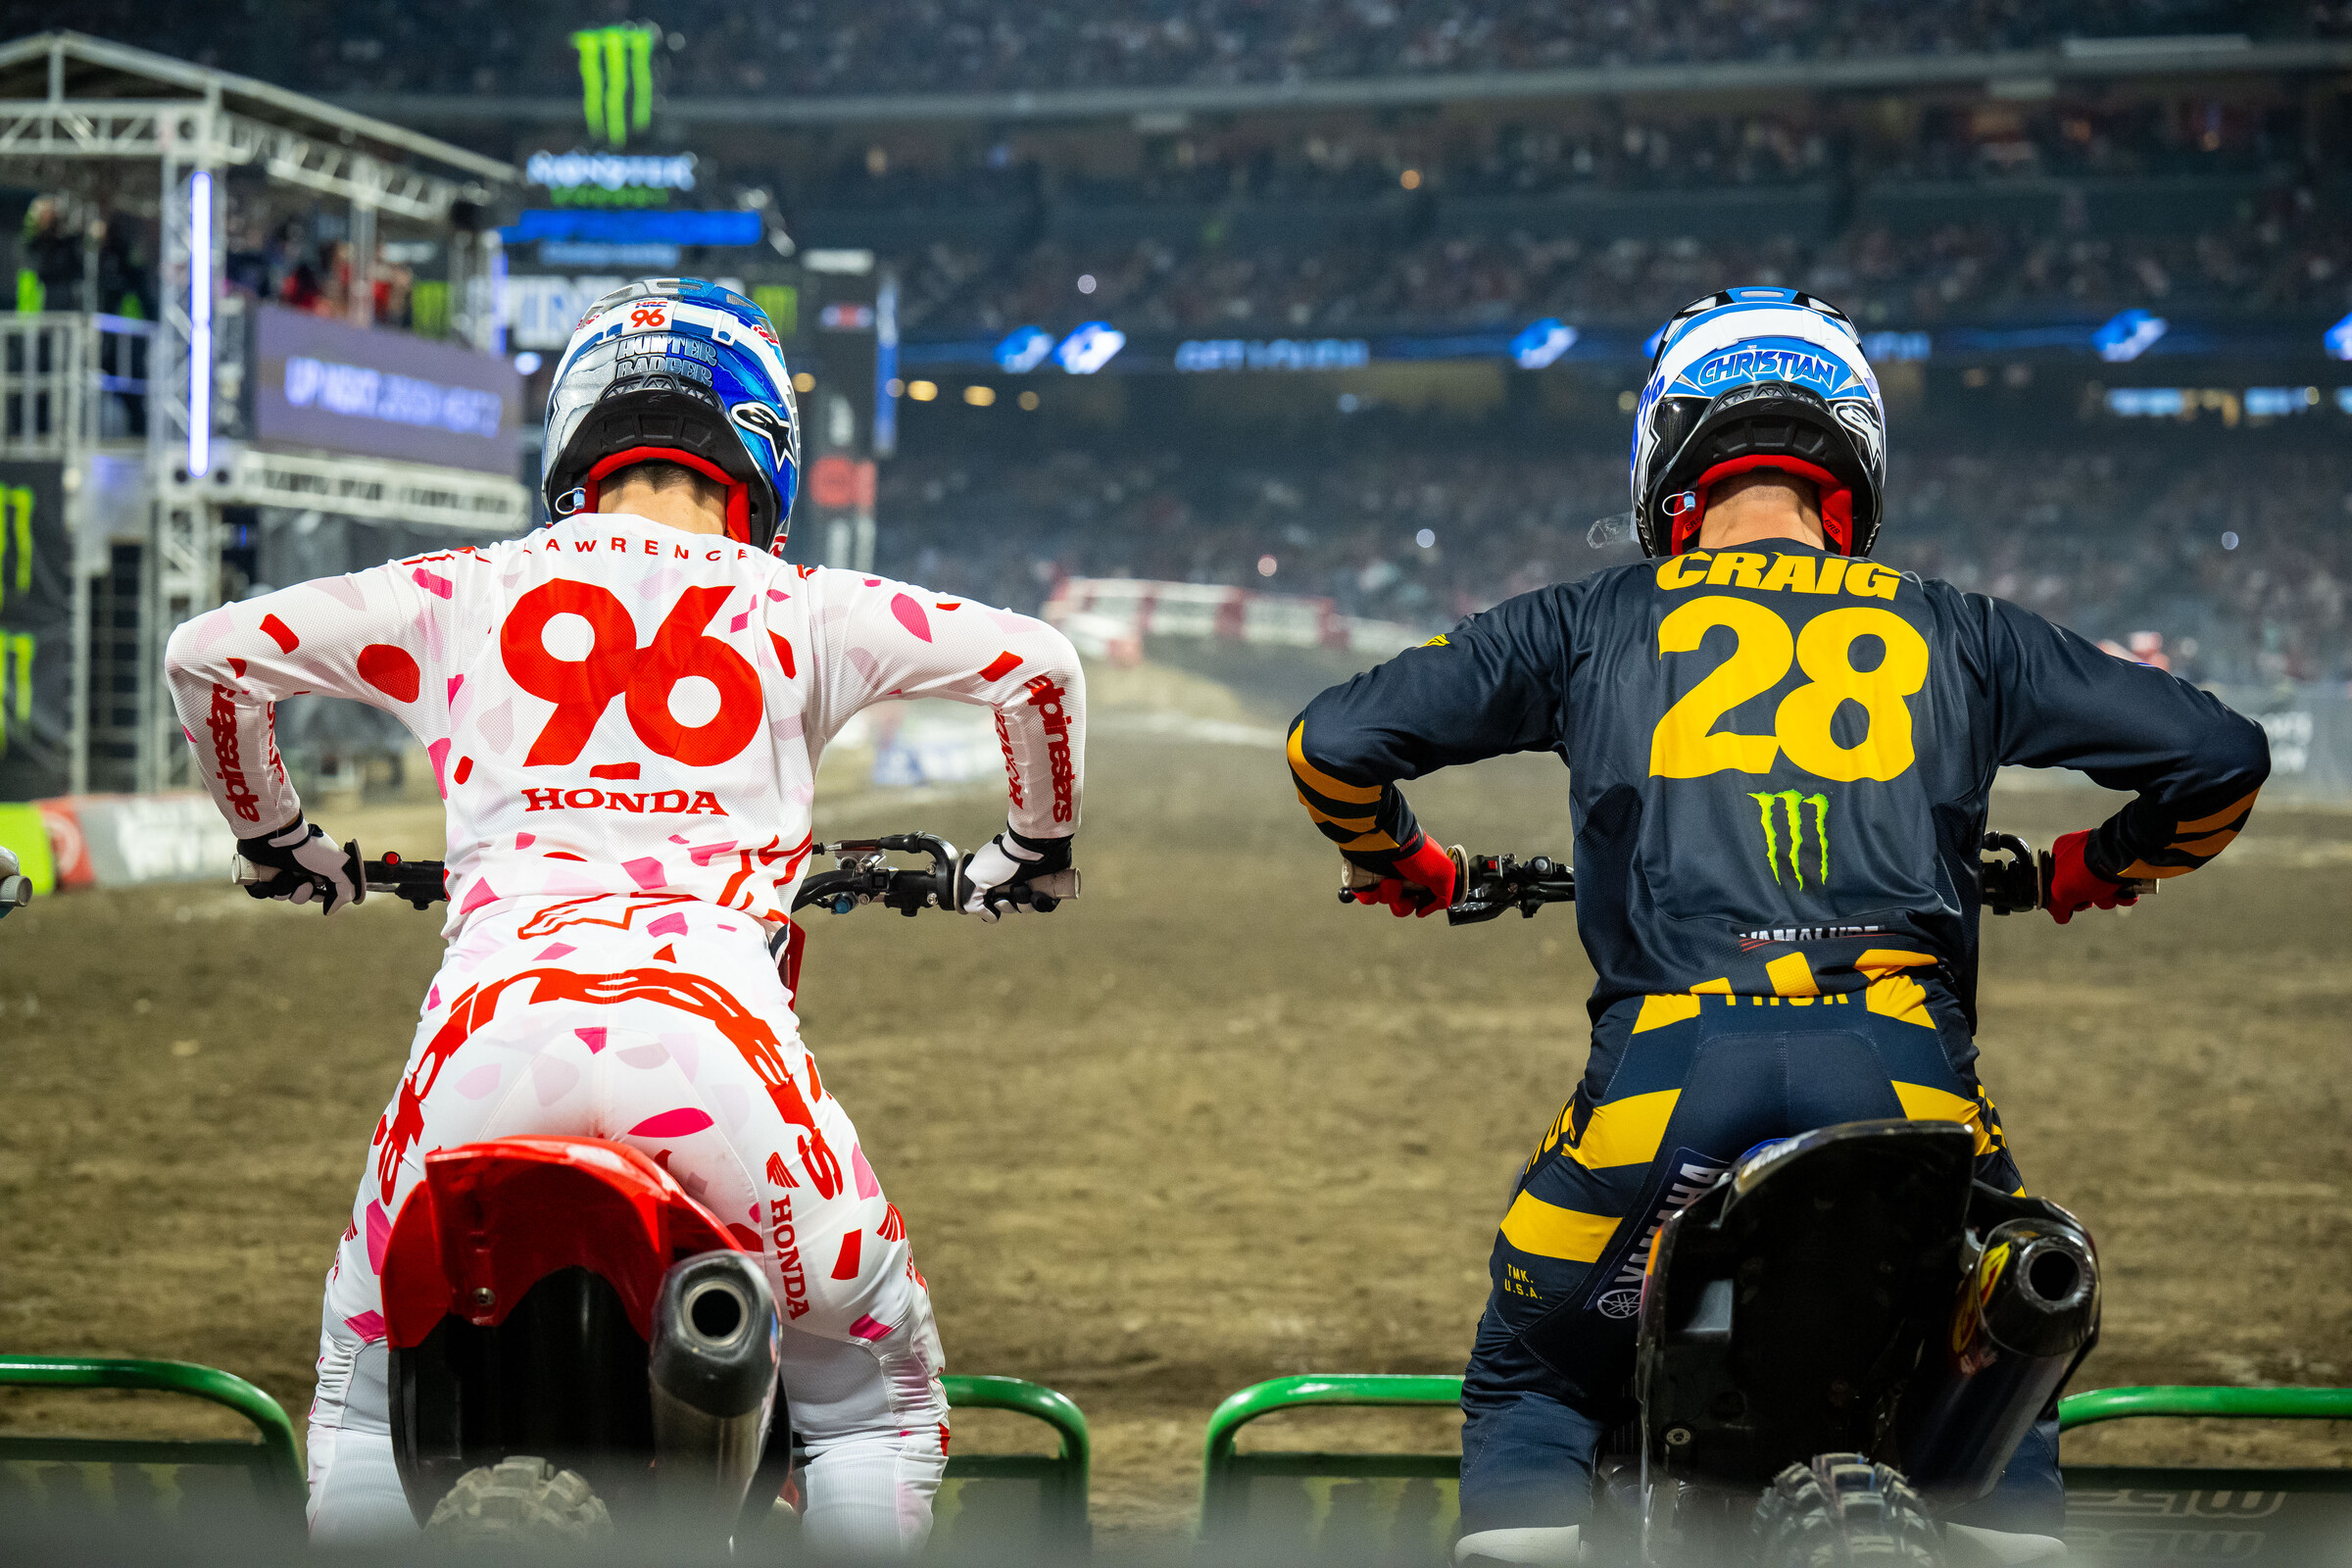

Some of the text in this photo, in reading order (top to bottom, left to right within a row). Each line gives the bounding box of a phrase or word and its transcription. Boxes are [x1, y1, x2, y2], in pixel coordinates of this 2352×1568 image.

[630, 308, 665, 328] 96
[616, 335, 717, 367] HUNTER
[616, 356, 713, 387] BADGER
[1698, 350, 1836, 389] CHRISTIAN
[1657, 551, 1900, 601] CRAIG
[500, 577, 763, 767] 96
[1648, 595, 1930, 782] 28
[522, 787, 729, 816] HONDA
[1614, 1163, 1727, 1283] YHA
[770, 1194, 810, 1320] HONDA
[1507, 1263, 1534, 1284] TMK.
[1504, 1278, 1543, 1299] U.S.A.
